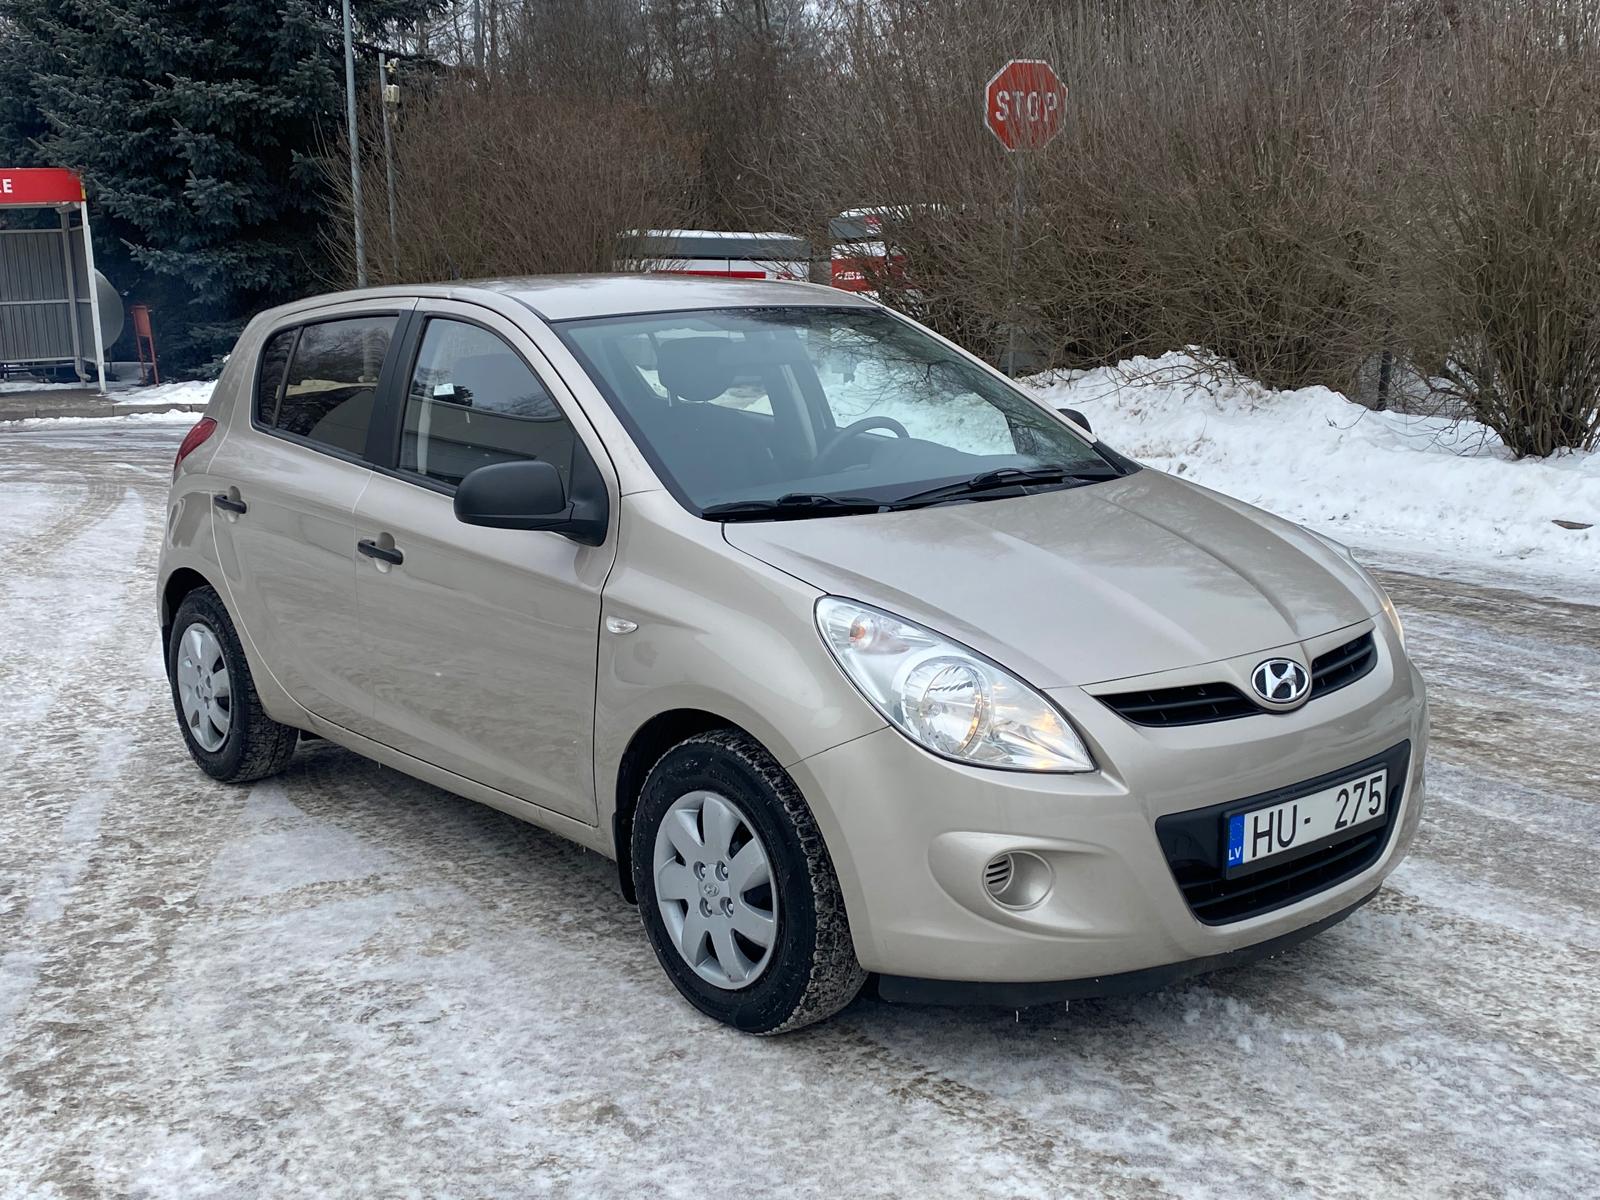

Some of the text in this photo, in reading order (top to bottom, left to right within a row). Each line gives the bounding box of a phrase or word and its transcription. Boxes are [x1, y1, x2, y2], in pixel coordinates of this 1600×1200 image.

[995, 90, 1057, 122] STOP
[1334, 775, 1383, 830] 275
[1228, 846, 1241, 861] LV
